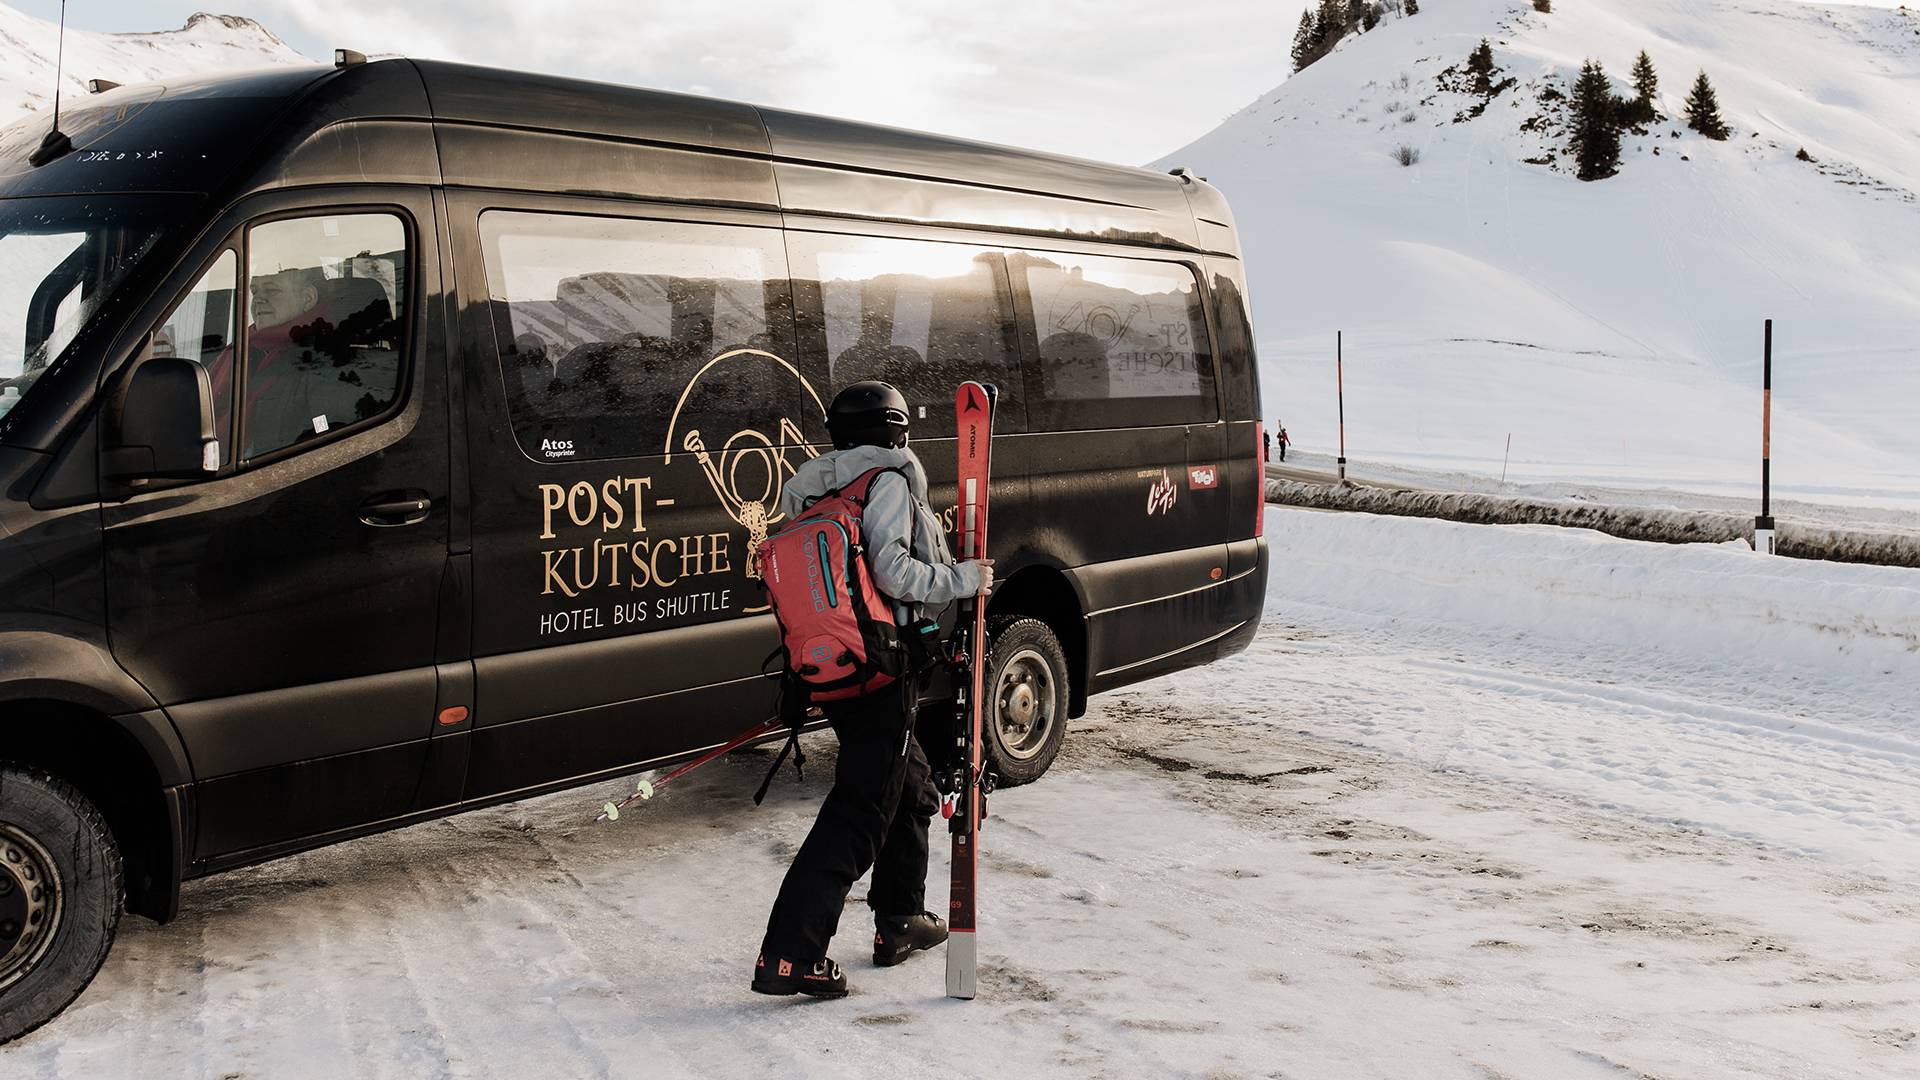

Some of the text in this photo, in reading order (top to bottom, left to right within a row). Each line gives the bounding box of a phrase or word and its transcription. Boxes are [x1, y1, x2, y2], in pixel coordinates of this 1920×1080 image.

[541, 438, 574, 451] Atos
[969, 424, 977, 459] ATOMIC
[538, 475, 675, 540] POST-
[540, 532, 731, 597] KUTSCHE
[803, 531, 826, 613] ORTOVOX
[540, 589, 731, 635] HOTEL BUS SHUTTLE
